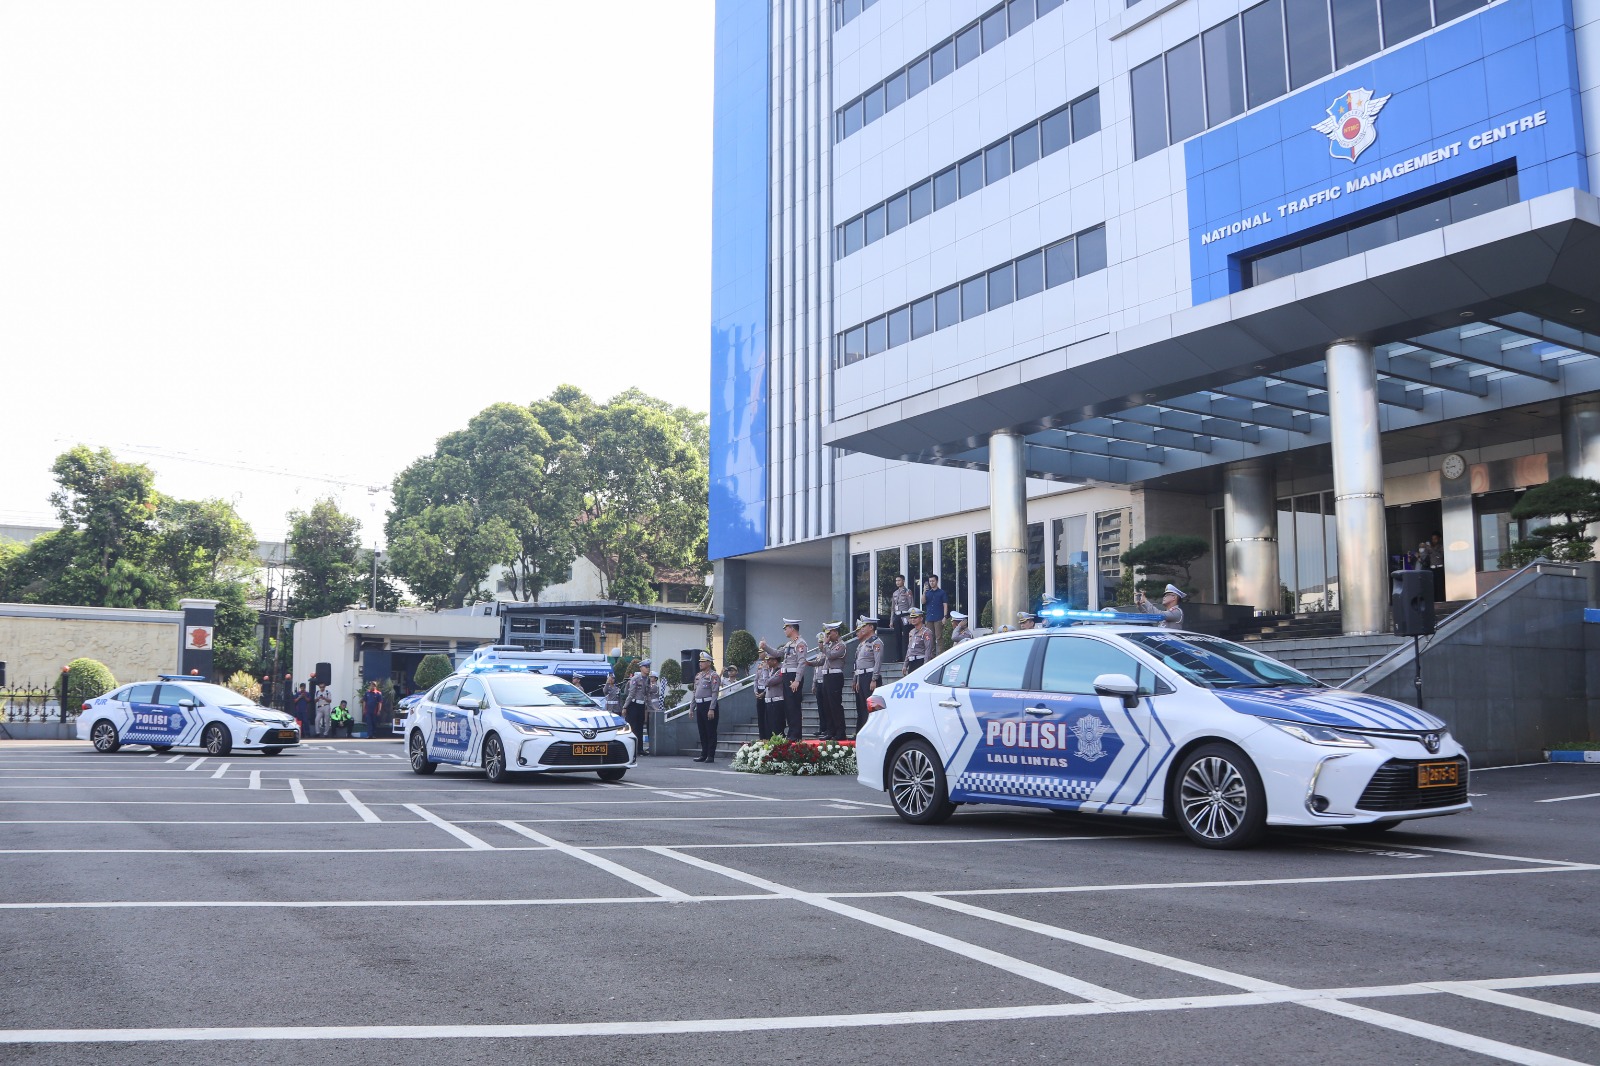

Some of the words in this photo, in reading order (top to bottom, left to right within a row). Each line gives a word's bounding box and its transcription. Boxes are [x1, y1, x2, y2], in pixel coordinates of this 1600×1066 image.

[1343, 124, 1360, 134] NTMC
[1201, 212, 1272, 246] NATIONAL
[1277, 186, 1342, 219] TRAFFIC
[1346, 141, 1463, 194] MANAGEMENT
[1468, 110, 1548, 151] CENTRE
[890, 682, 920, 699] PJR
[94, 698, 108, 706] PJR
[135, 713, 168, 725] POLISI
[437, 720, 458, 736] POLISI
[986, 720, 1068, 751] POLISI
[987, 753, 1018, 764] LALU
[1021, 755, 1068, 768] LINTAS
